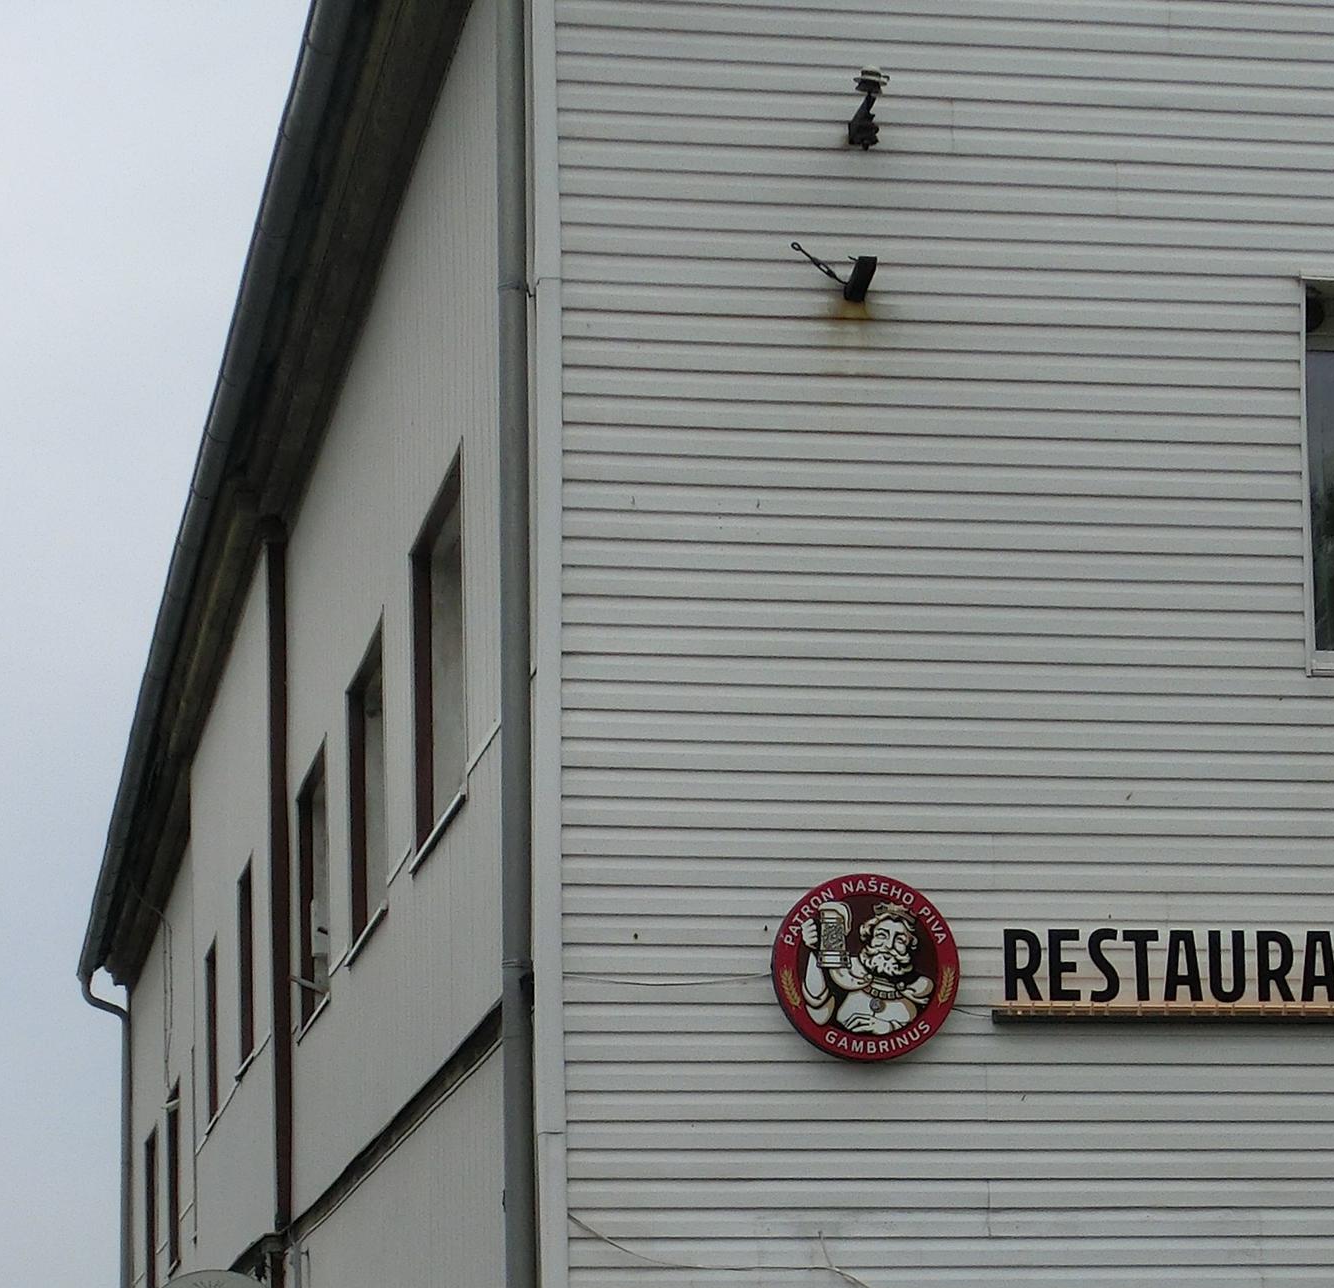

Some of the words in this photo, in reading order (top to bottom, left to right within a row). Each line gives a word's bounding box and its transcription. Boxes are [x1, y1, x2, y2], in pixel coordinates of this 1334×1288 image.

[784, 888, 835, 946] PATRON
[842, 877, 915, 904] NAŠEHO
[918, 906, 948, 944] PIVA
[825, 1020, 930, 1054] GAMBRINUS
